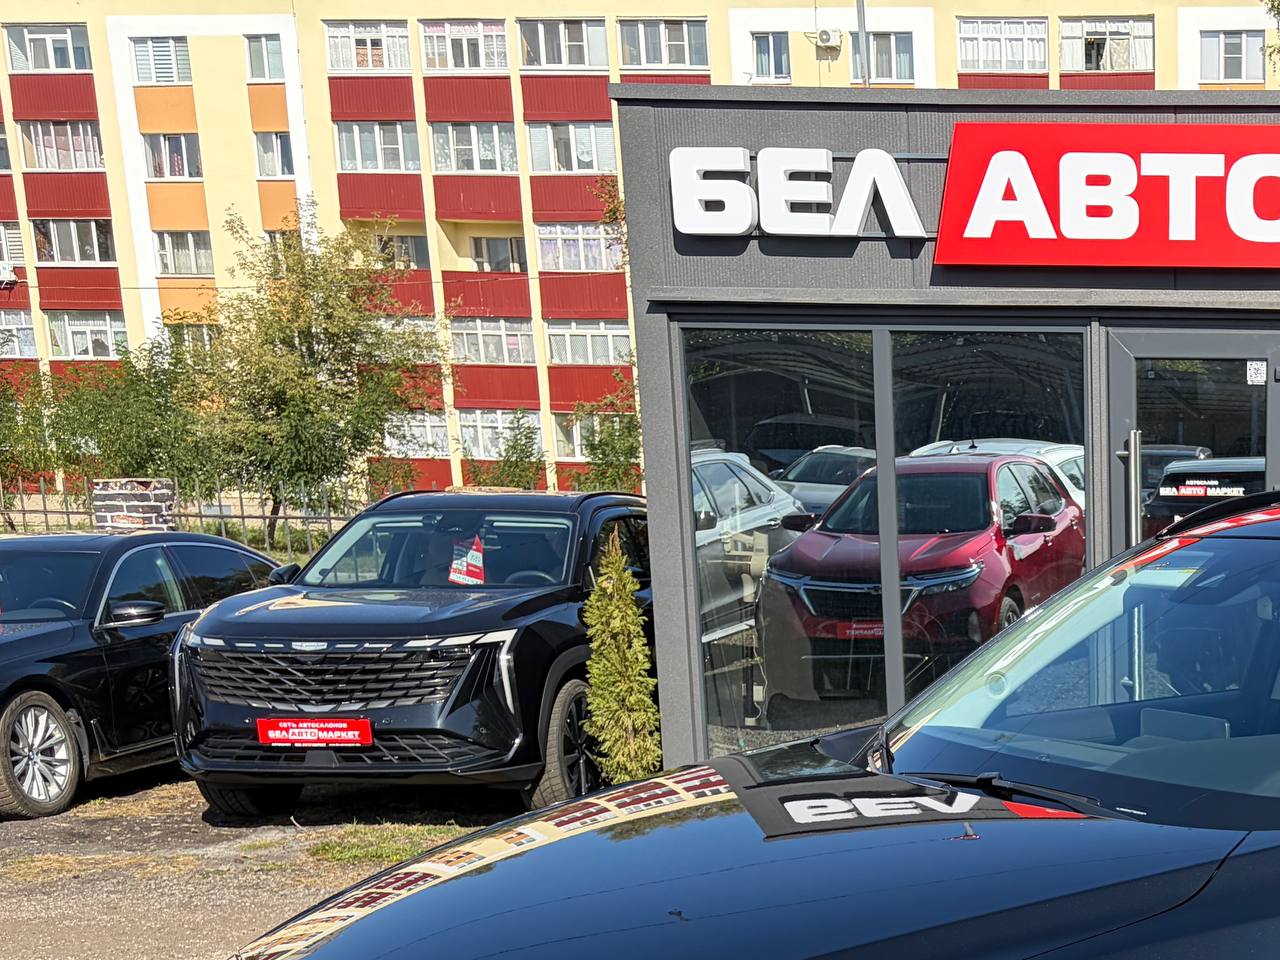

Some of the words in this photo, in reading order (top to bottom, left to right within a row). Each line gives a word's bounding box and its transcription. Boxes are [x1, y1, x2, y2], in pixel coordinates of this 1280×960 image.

[669, 146, 928, 237] БЕЛ
[268, 730, 288, 739] БЕЛ
[318, 730, 360, 739] МАРКЕТ
